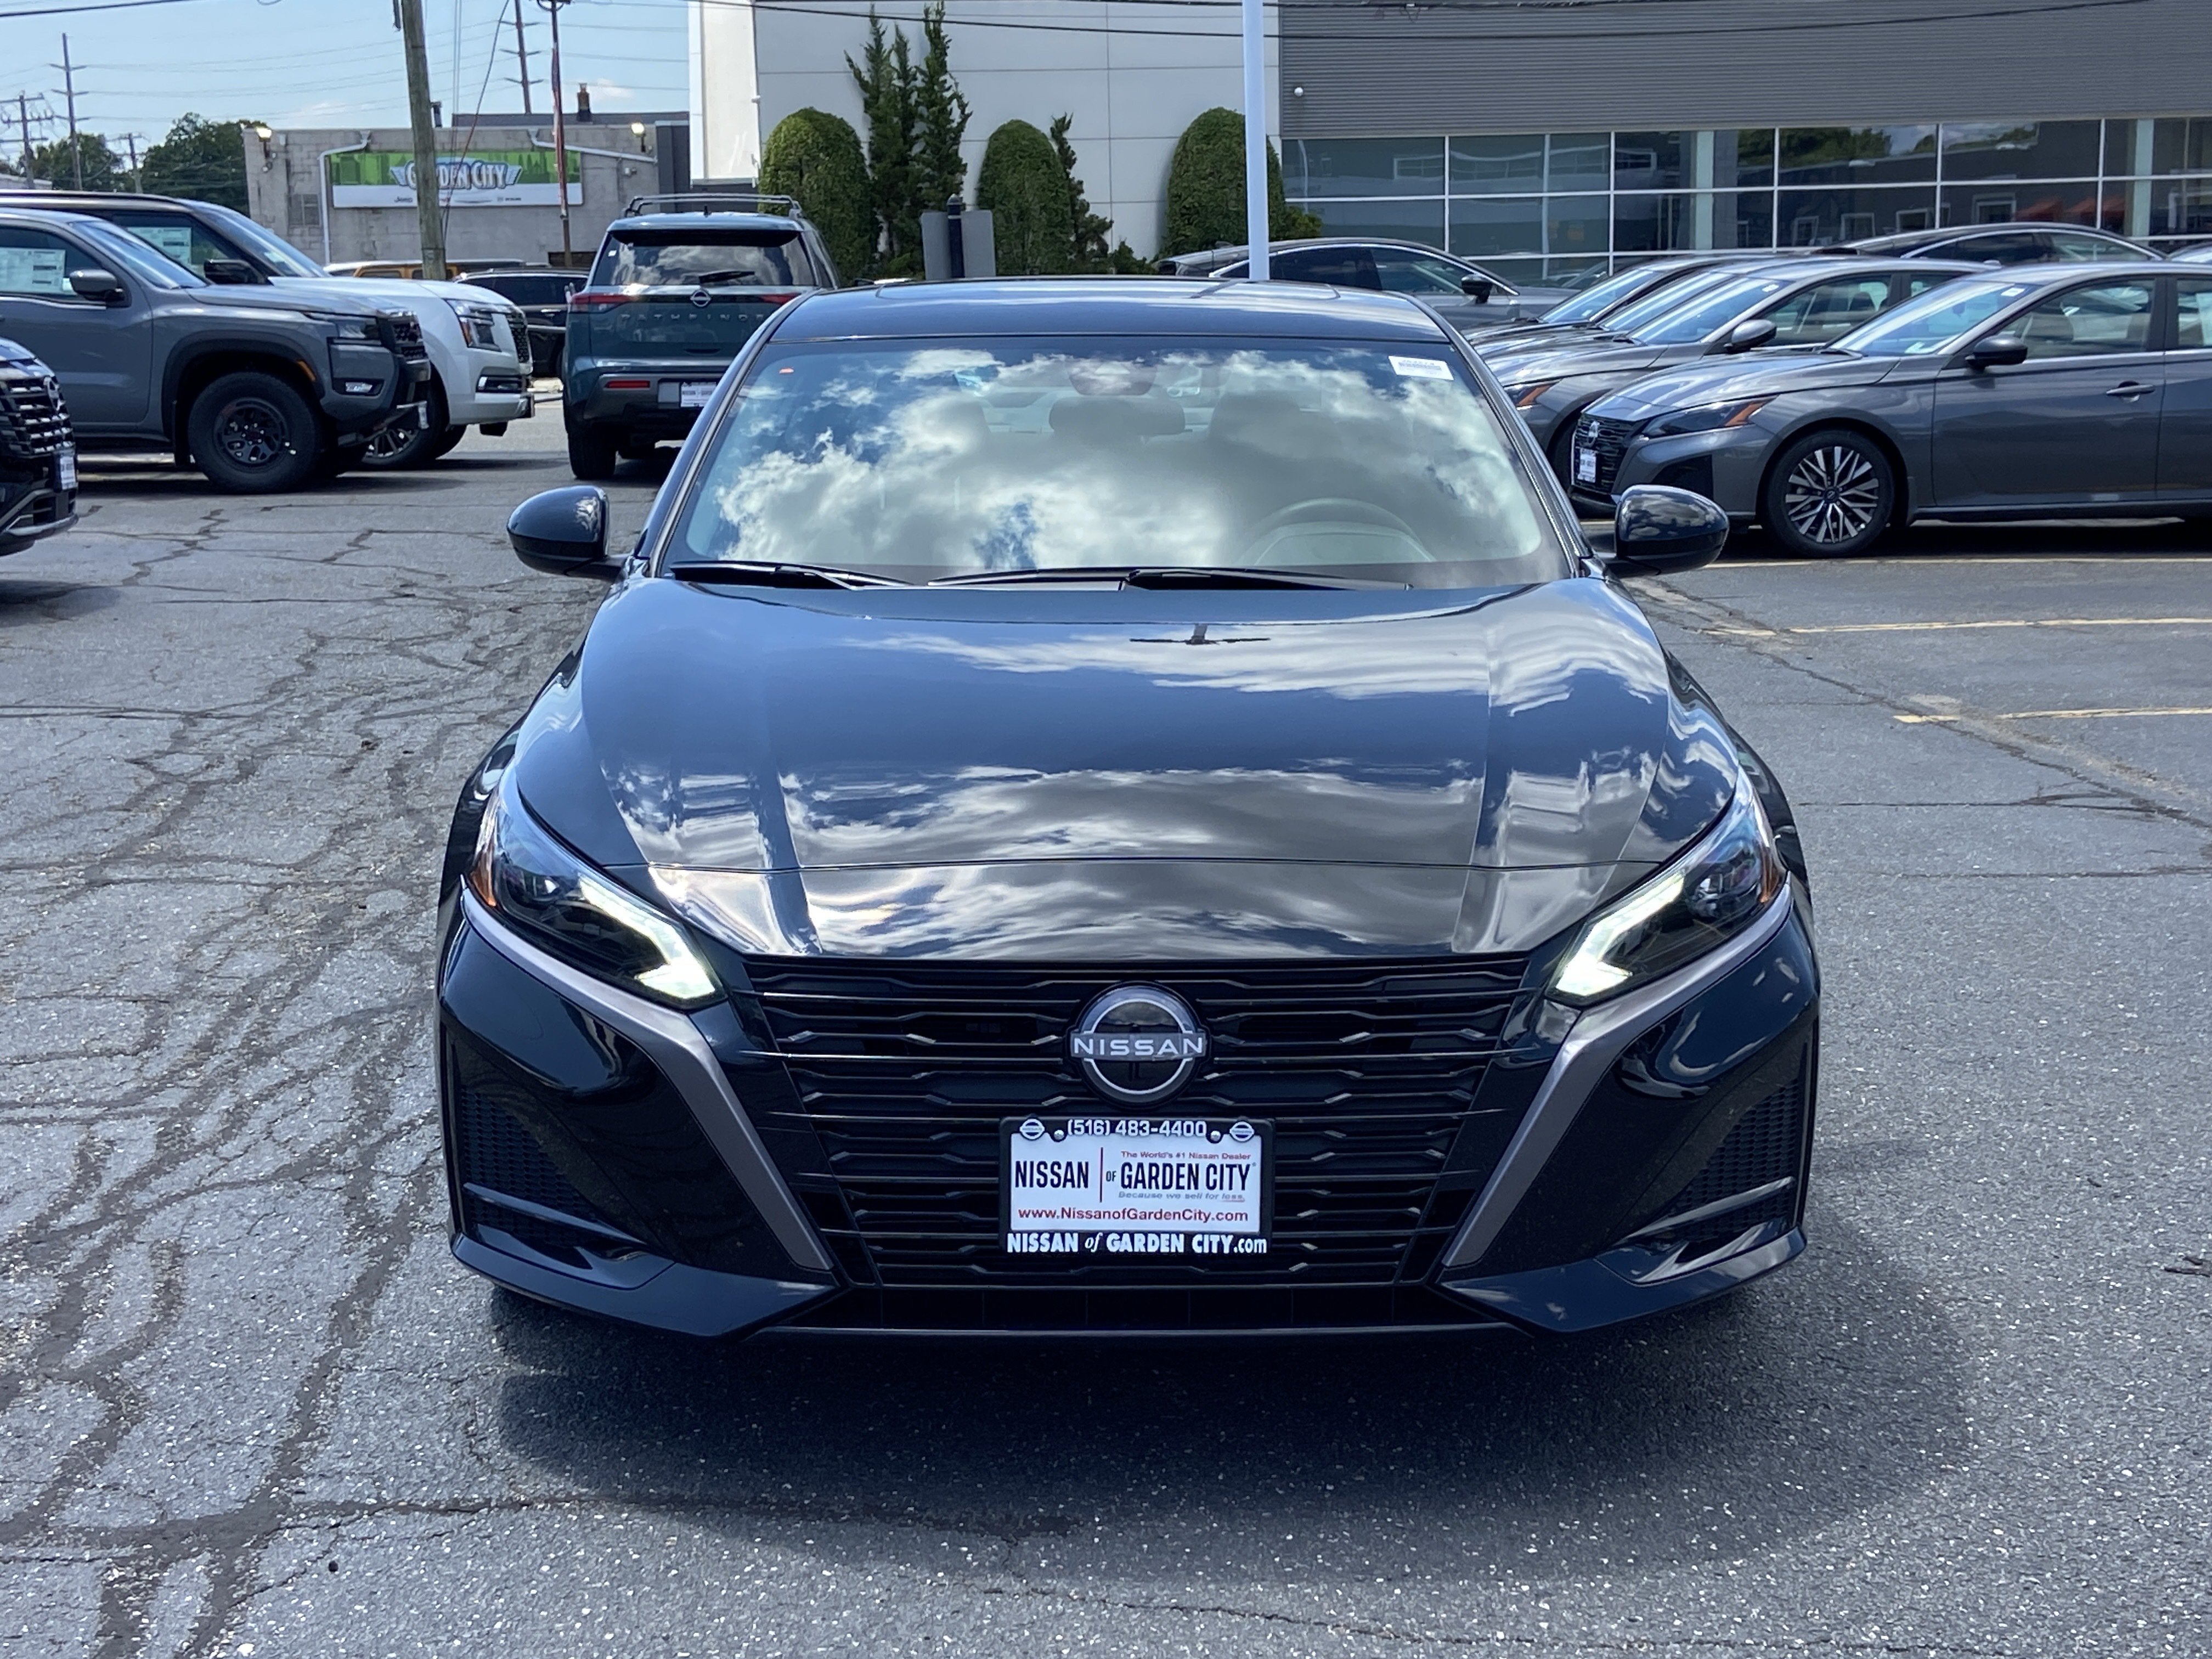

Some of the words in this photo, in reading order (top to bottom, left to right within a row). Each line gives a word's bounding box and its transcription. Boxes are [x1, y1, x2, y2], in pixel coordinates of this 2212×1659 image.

[406, 162, 471, 188] GDEN
[472, 161, 505, 188] CITY
[1074, 1037, 1203, 1056] NISSAN
[1067, 1119, 1110, 1136] (516)
[1115, 1120, 1207, 1137] 483-4400
[1015, 1161, 1089, 1188] NISSAN
[1105, 1171, 1116, 1182] OF
[1121, 1162, 1199, 1190] GARDEN
[1205, 1163, 1251, 1190] CITY
[1118, 1191, 1163, 1199] Because
[1018, 1206, 1249, 1223] www.NissanofGardenCity.com
[1007, 1232, 1079, 1252] NISSAN
[1084, 1232, 1103, 1252] of
[1106, 1232, 1185, 1252] GARDEN
[1192, 1234, 1267, 1254] CITY.com
